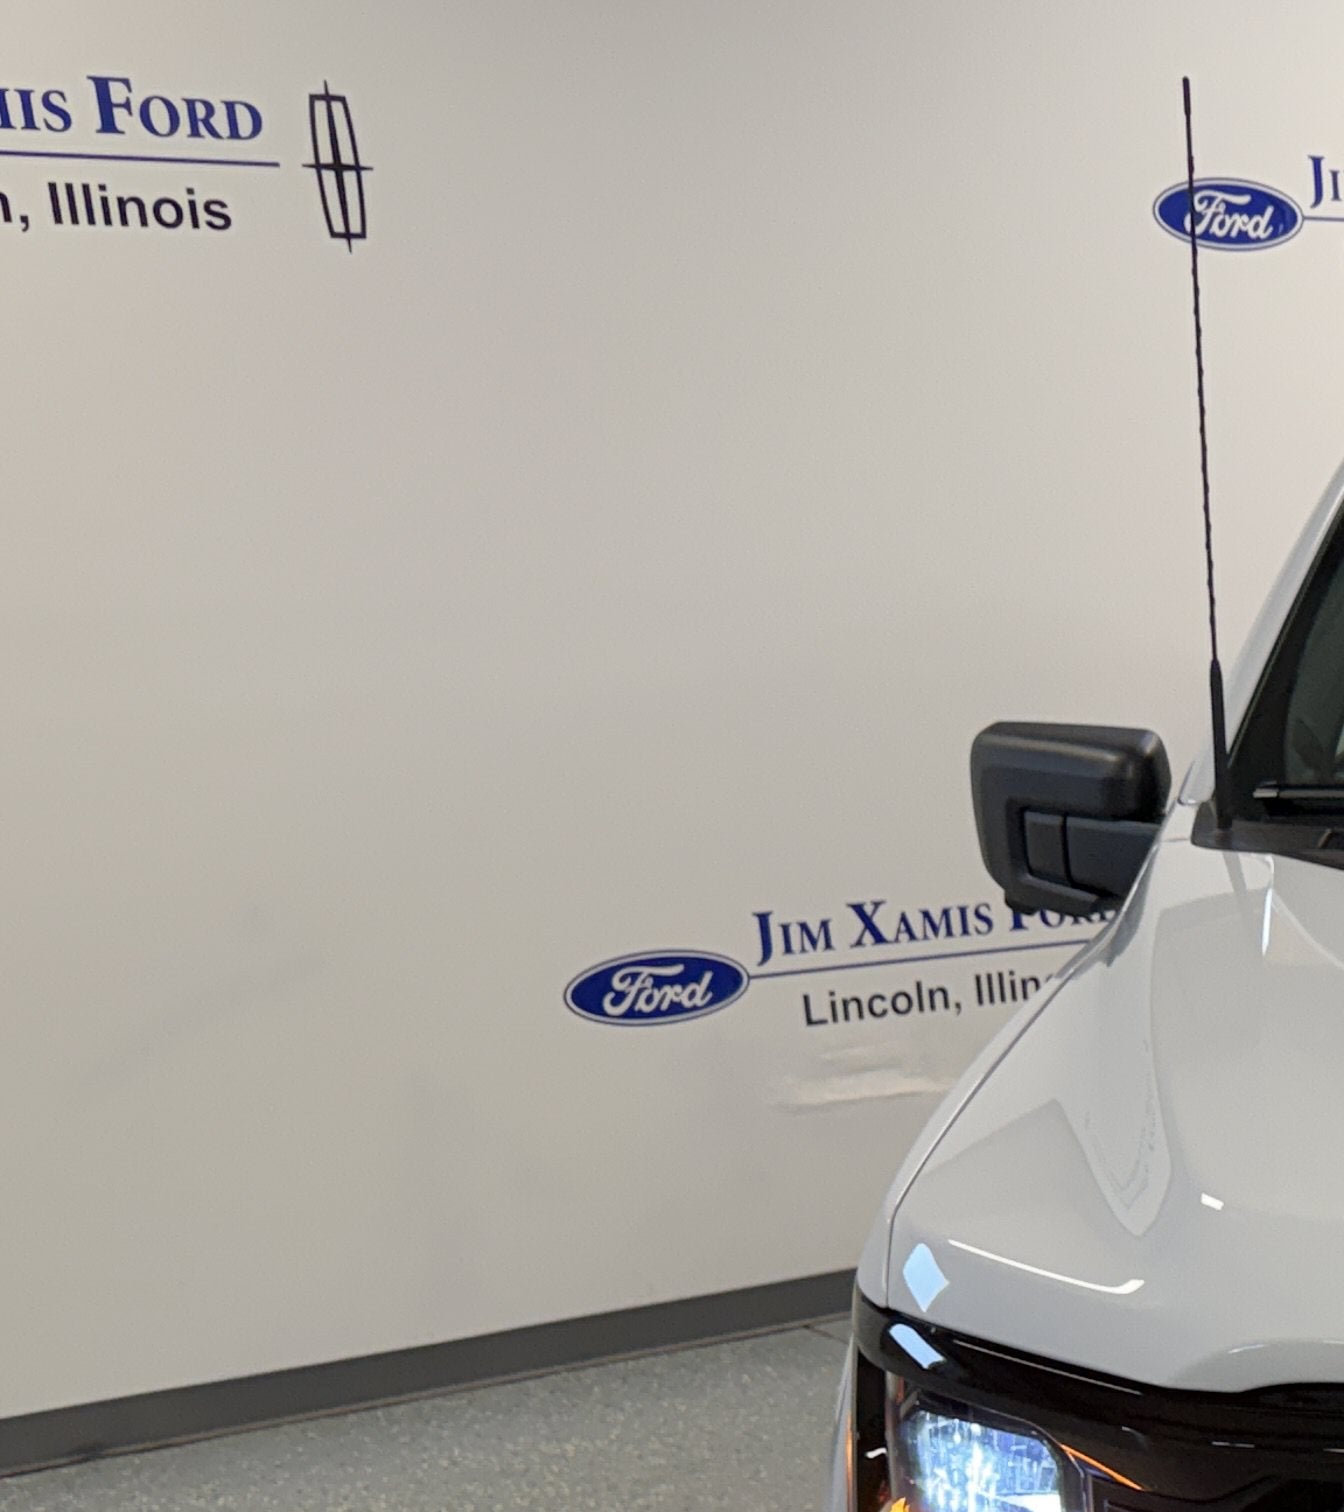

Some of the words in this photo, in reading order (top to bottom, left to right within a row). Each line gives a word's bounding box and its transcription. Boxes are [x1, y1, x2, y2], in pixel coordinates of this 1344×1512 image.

[87, 75, 263, 140] FORD
[48, 182, 232, 230] Illinois
[1184, 189, 1272, 239] Ford
[752, 911, 833, 966] JIM
[846, 900, 994, 948] XAMIS
[603, 965, 713, 1015] Ford
[803, 980, 963, 1027] Lincoln,
[975, 968, 1053, 1006] Illin
